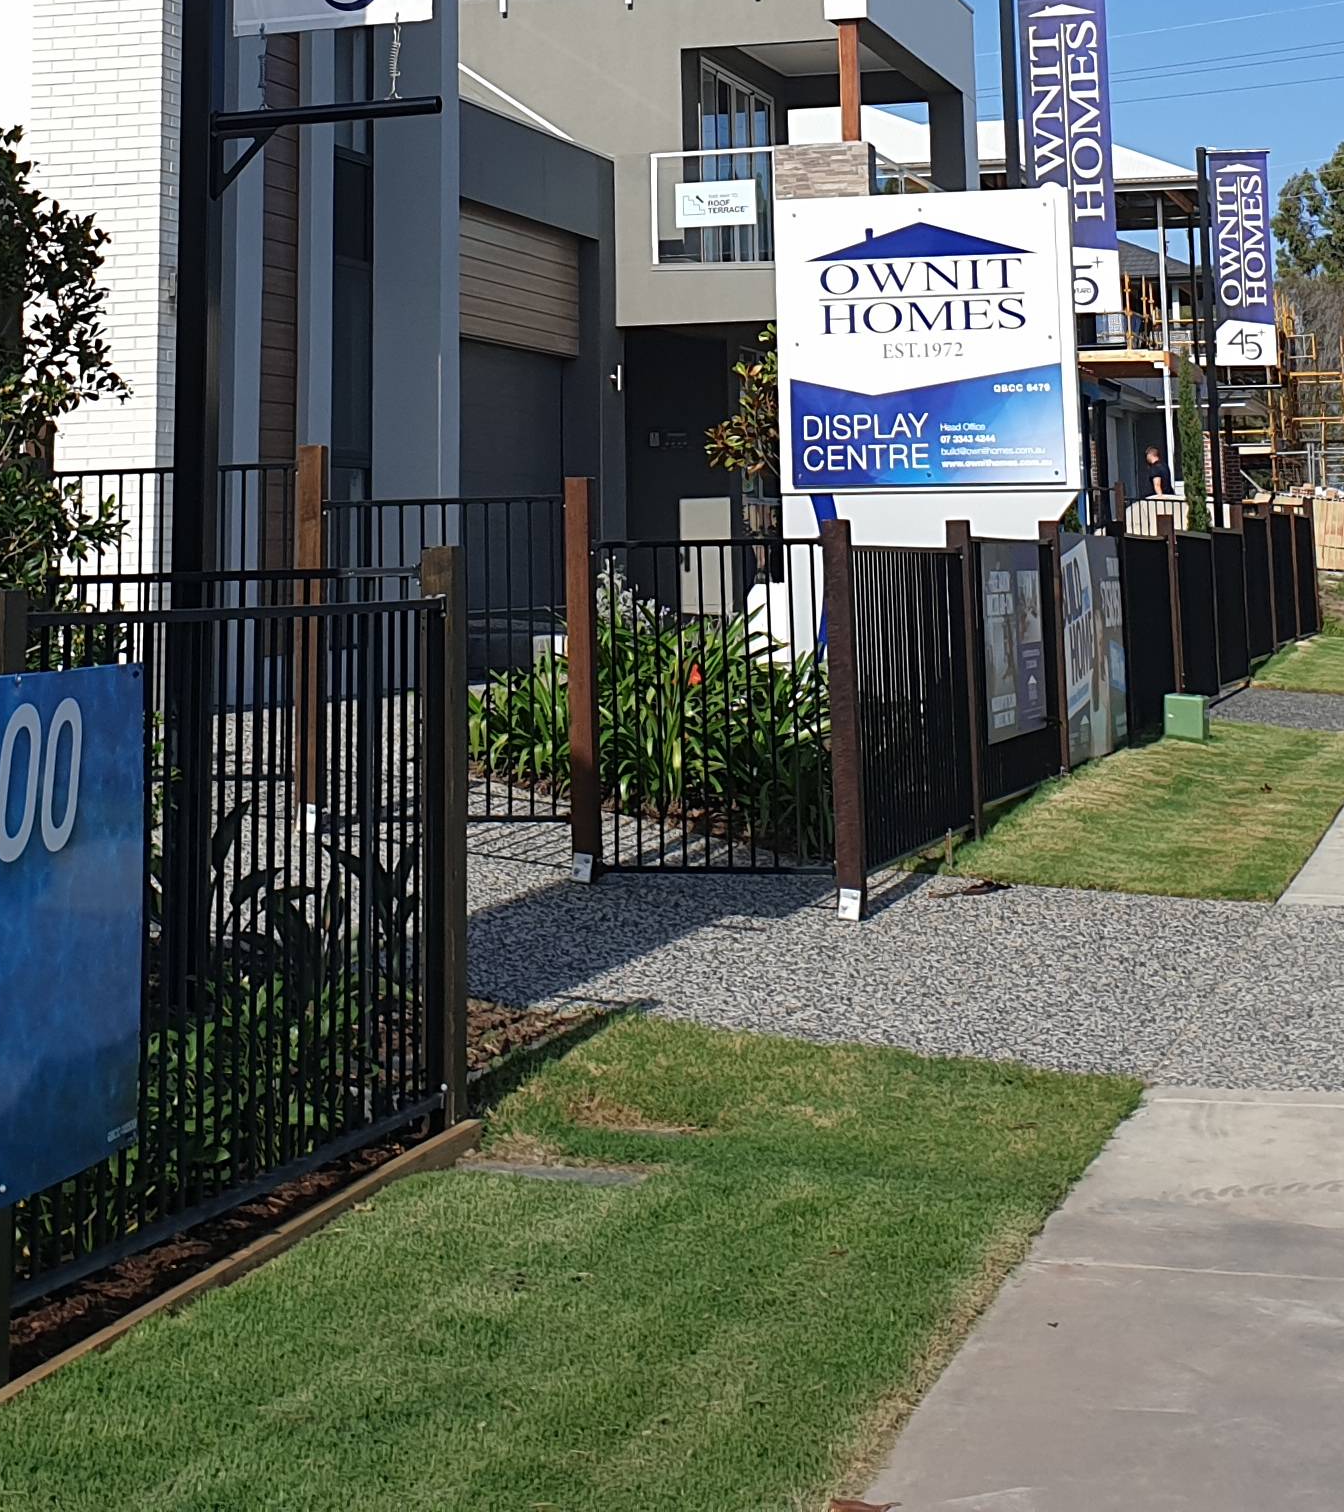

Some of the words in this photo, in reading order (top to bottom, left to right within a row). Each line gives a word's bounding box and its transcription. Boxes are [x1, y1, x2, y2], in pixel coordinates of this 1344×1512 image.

[1028, 25, 1067, 188] WNIT
[1066, 20, 1106, 223] HOMES
[707, 205, 746, 214] TERRACE
[1215, 177, 1243, 308] OWNIT
[1240, 174, 1268, 307] HOMES
[819, 257, 1023, 296] OWNIT
[820, 297, 1027, 336] HOMES
[882, 342, 965, 360] EST.1972
[993, 384, 1024, 393] QBCC
[802, 412, 929, 442] DISPLAY
[939, 423, 962, 432] Head
[962, 422, 986, 431] Office
[940, 435, 951, 444] 07
[803, 443, 930, 472] CENTRE
